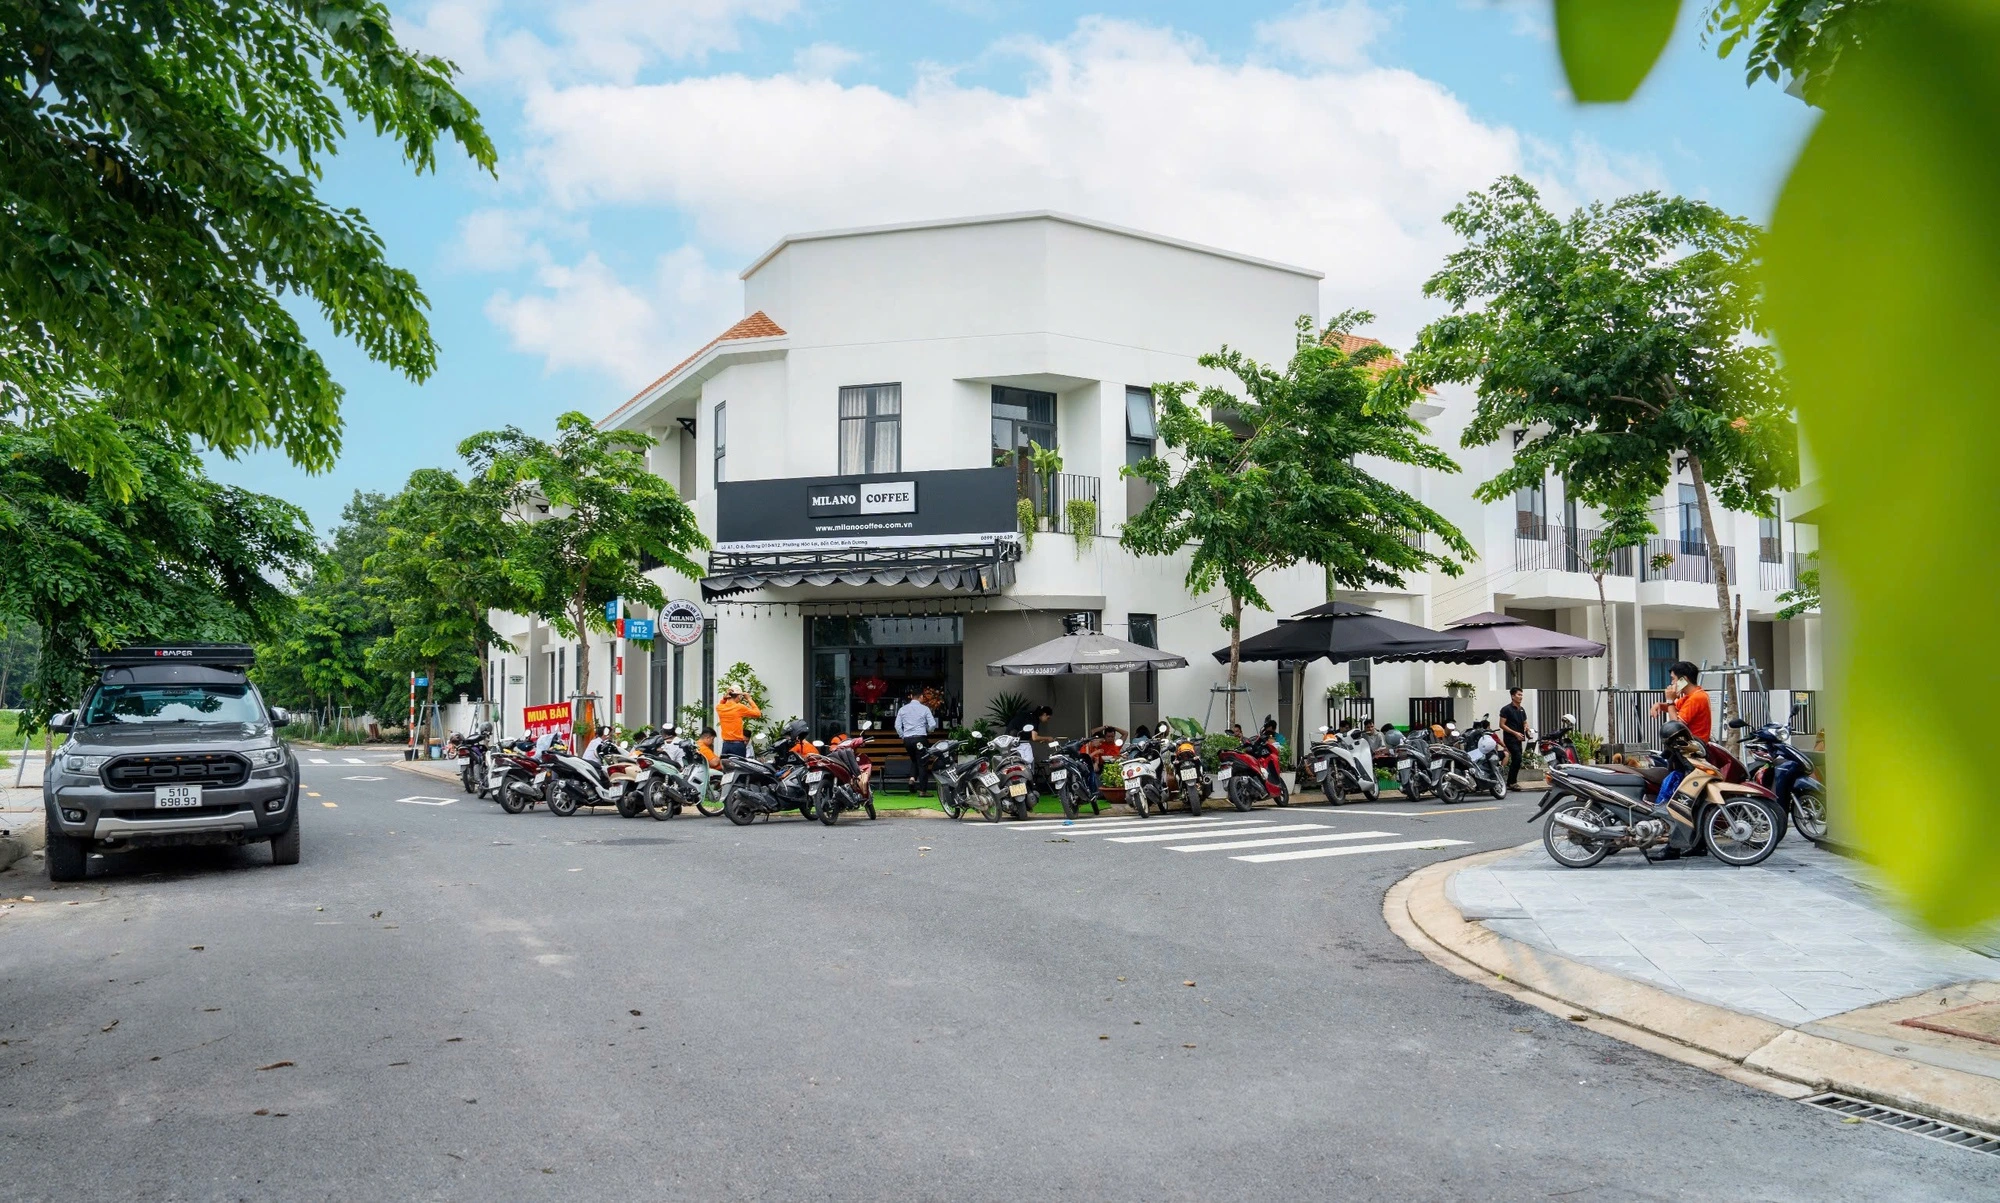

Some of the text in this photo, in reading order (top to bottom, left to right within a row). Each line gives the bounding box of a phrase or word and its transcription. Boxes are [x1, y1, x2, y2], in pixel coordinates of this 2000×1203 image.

[812, 492, 910, 506] MILANO COFFEE
[815, 521, 913, 533] www.milanocoffee.com.vn
[631, 625, 648, 634] N12
[527, 706, 568, 722] MUA BÁN
[118, 764, 235, 777] FORD
[169, 788, 189, 797] 51D
[160, 797, 197, 807] 698.93
